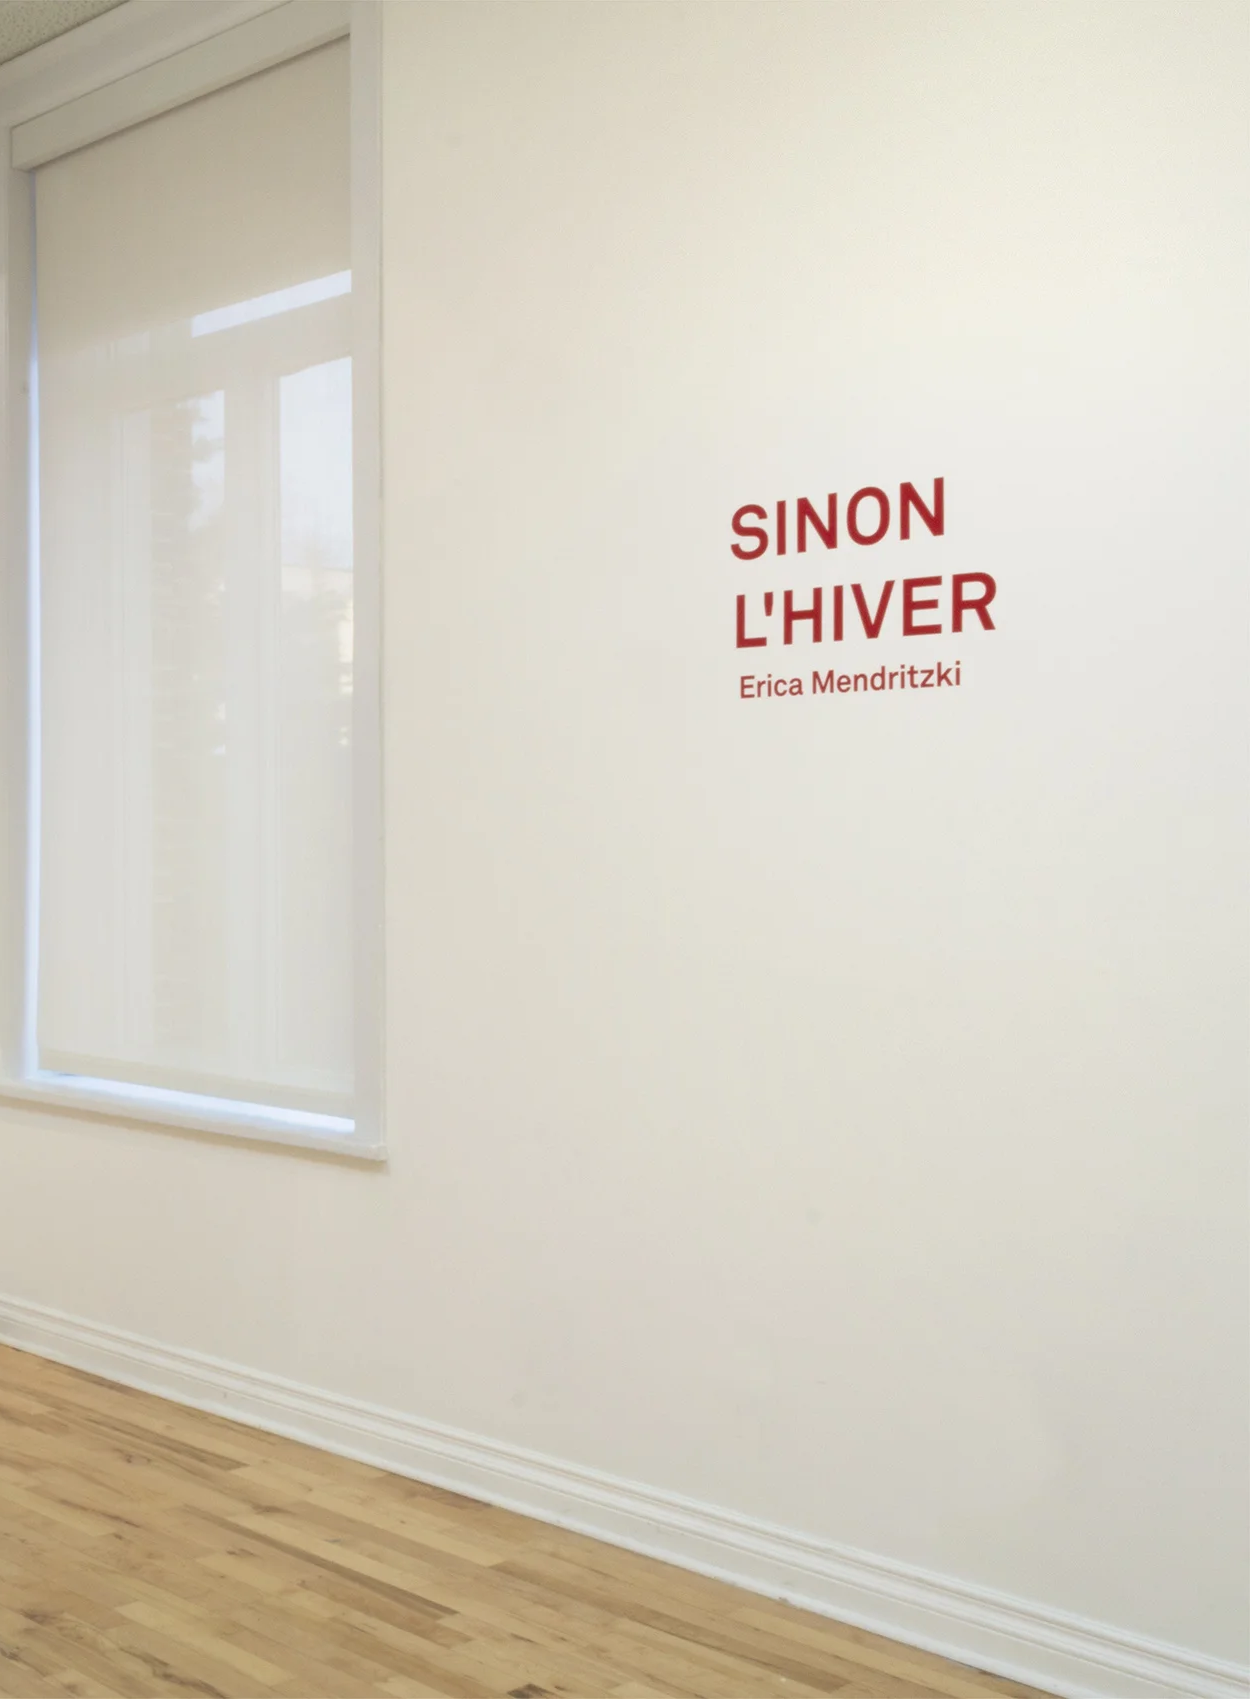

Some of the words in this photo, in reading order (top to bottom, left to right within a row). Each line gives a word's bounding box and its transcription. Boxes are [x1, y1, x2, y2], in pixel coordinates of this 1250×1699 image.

[730, 477, 945, 561] SINON
[736, 572, 997, 649] L'HIVER
[740, 674, 803, 699] Erica
[812, 660, 961, 694] Mendritzki
